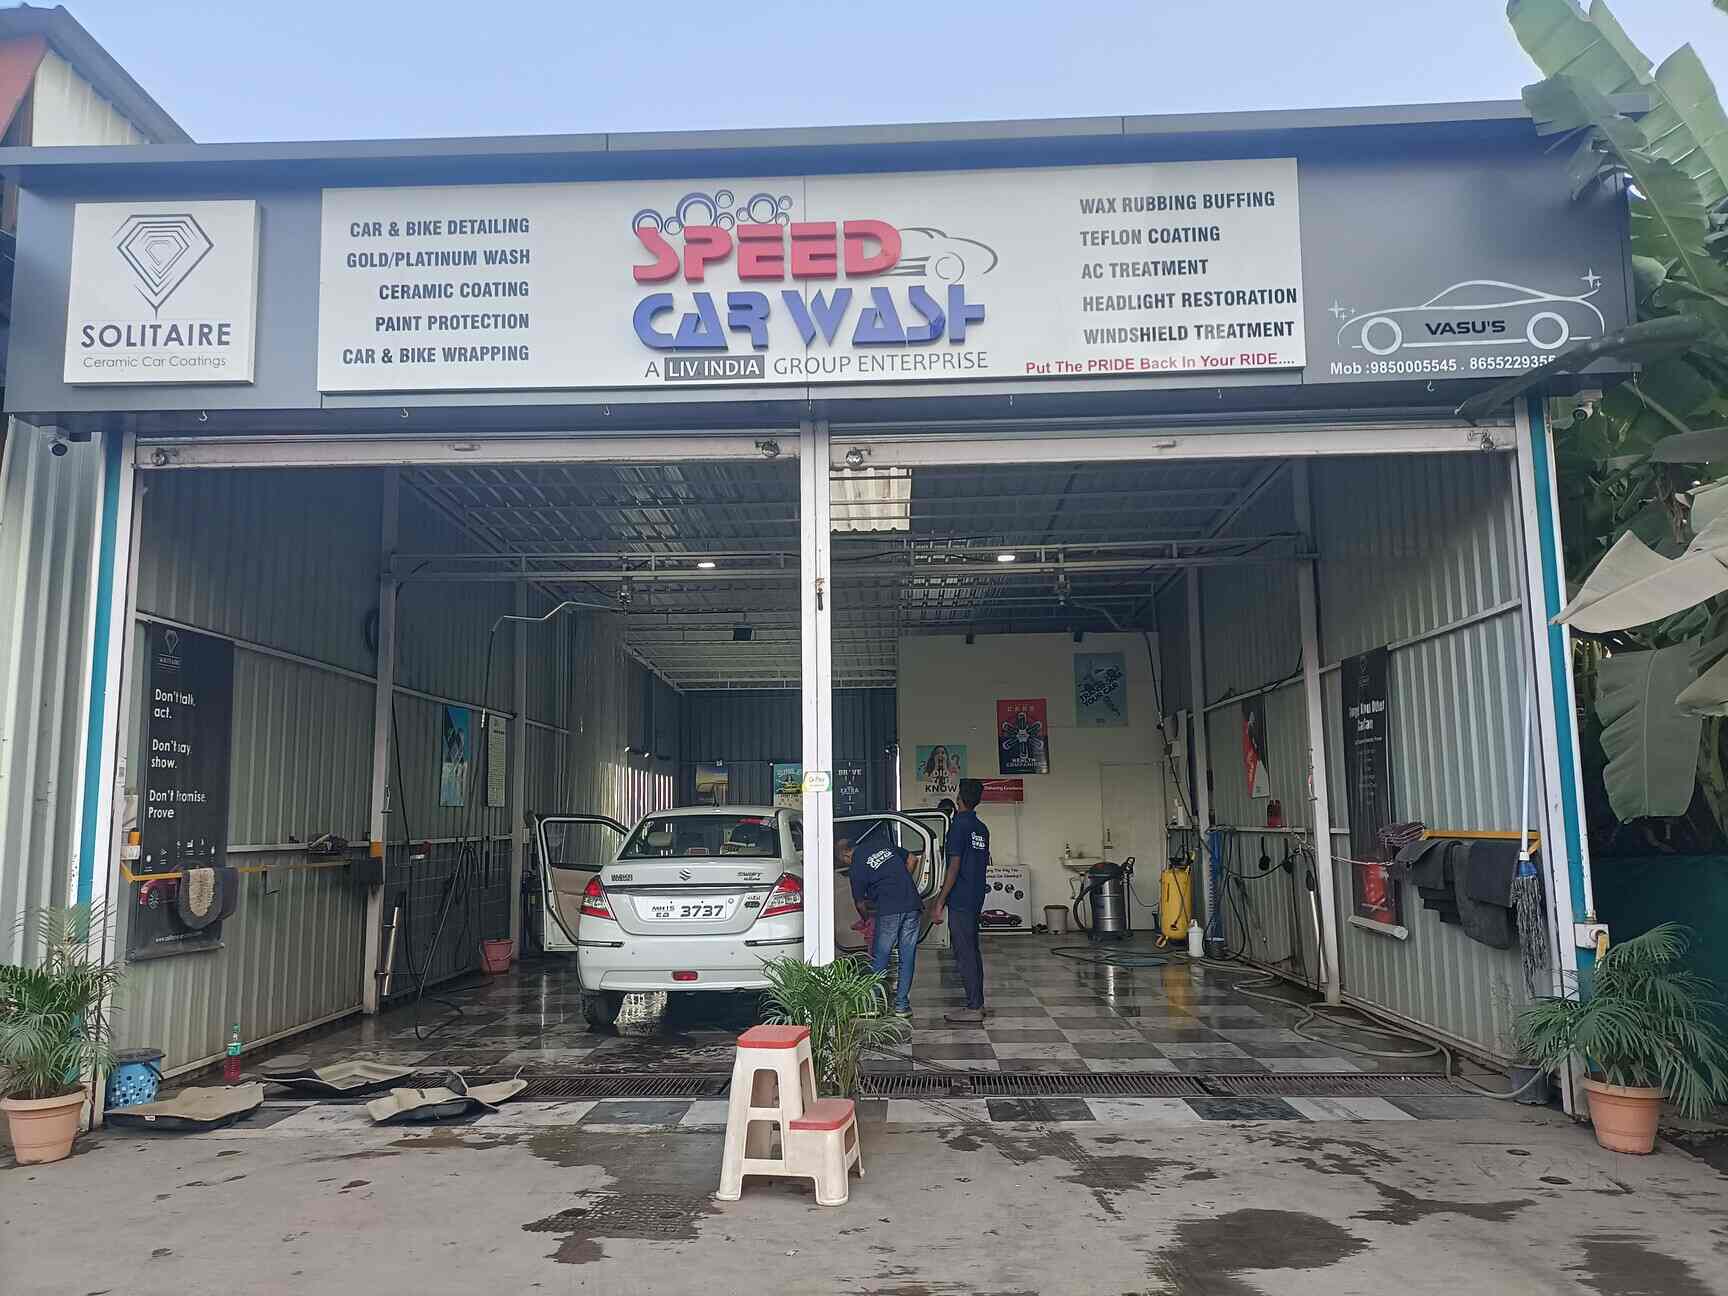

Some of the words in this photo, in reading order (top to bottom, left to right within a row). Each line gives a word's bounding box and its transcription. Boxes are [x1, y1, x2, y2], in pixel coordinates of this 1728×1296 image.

[1080, 198, 1117, 214] WAX
[1122, 194, 1196, 213] RUBBING
[1202, 191, 1275, 209] BUFFING
[350, 221, 382, 237] CAR
[388, 221, 401, 237] &
[406, 220, 442, 236] BIKE
[447, 218, 530, 235] DETAILING
[1080, 229, 1142, 247] TEFLON
[1148, 226, 1220, 244] COATING
[346, 250, 480, 268] GOLD/PLATINUM
[483, 249, 531, 266] WASH
[632, 219, 902, 284] SPEED
[1081, 263, 1104, 279] AC
[1109, 259, 1208, 279] TREATMENT
[379, 282, 454, 300] CERAMIC
[459, 280, 529, 298] COATING
[1083, 293, 1175, 312] HEADLIGHT
[1181, 288, 1297, 308] RESTORATION
[375, 315, 423, 333] PAINT
[427, 313, 529, 331] PROTECTION
[1425, 320, 1506, 336] VASU'S
[81, 322, 231, 348] SOLITAIRE
[1084, 325, 1188, 345] WINDSHIELD
[1194, 321, 1295, 341] TREATMENT
[83, 355, 138, 368] Ceramic
[142, 354, 165, 368] Car
[168, 353, 226, 370] Coatings
[342, 348, 376, 364] CAR
[381, 347, 394, 363] &
[399, 347, 437, 363] BIKE
[442, 345, 529, 363] WRAPPING
[645, 362, 660, 378] A
[774, 355, 851, 375] GROUP
[858, 351, 989, 372] ENTERPRISE
[1026, 362, 1052, 374] Put
[1055, 361, 1083, 373] The
[1088, 359, 1135, 372] PRIDE
[1140, 357, 1177, 370] Back
[1181, 356, 1196, 369] In
[1200, 355, 1236, 367] Your
[155, 688, 179, 703] Don't
[154, 707, 172, 719] act.
[152, 739, 177, 752] Don't
[151, 756, 178, 769] show.
[149, 789, 174, 802] Don't
[148, 807, 175, 819] Prove
[680, 905, 724, 917] 3737
